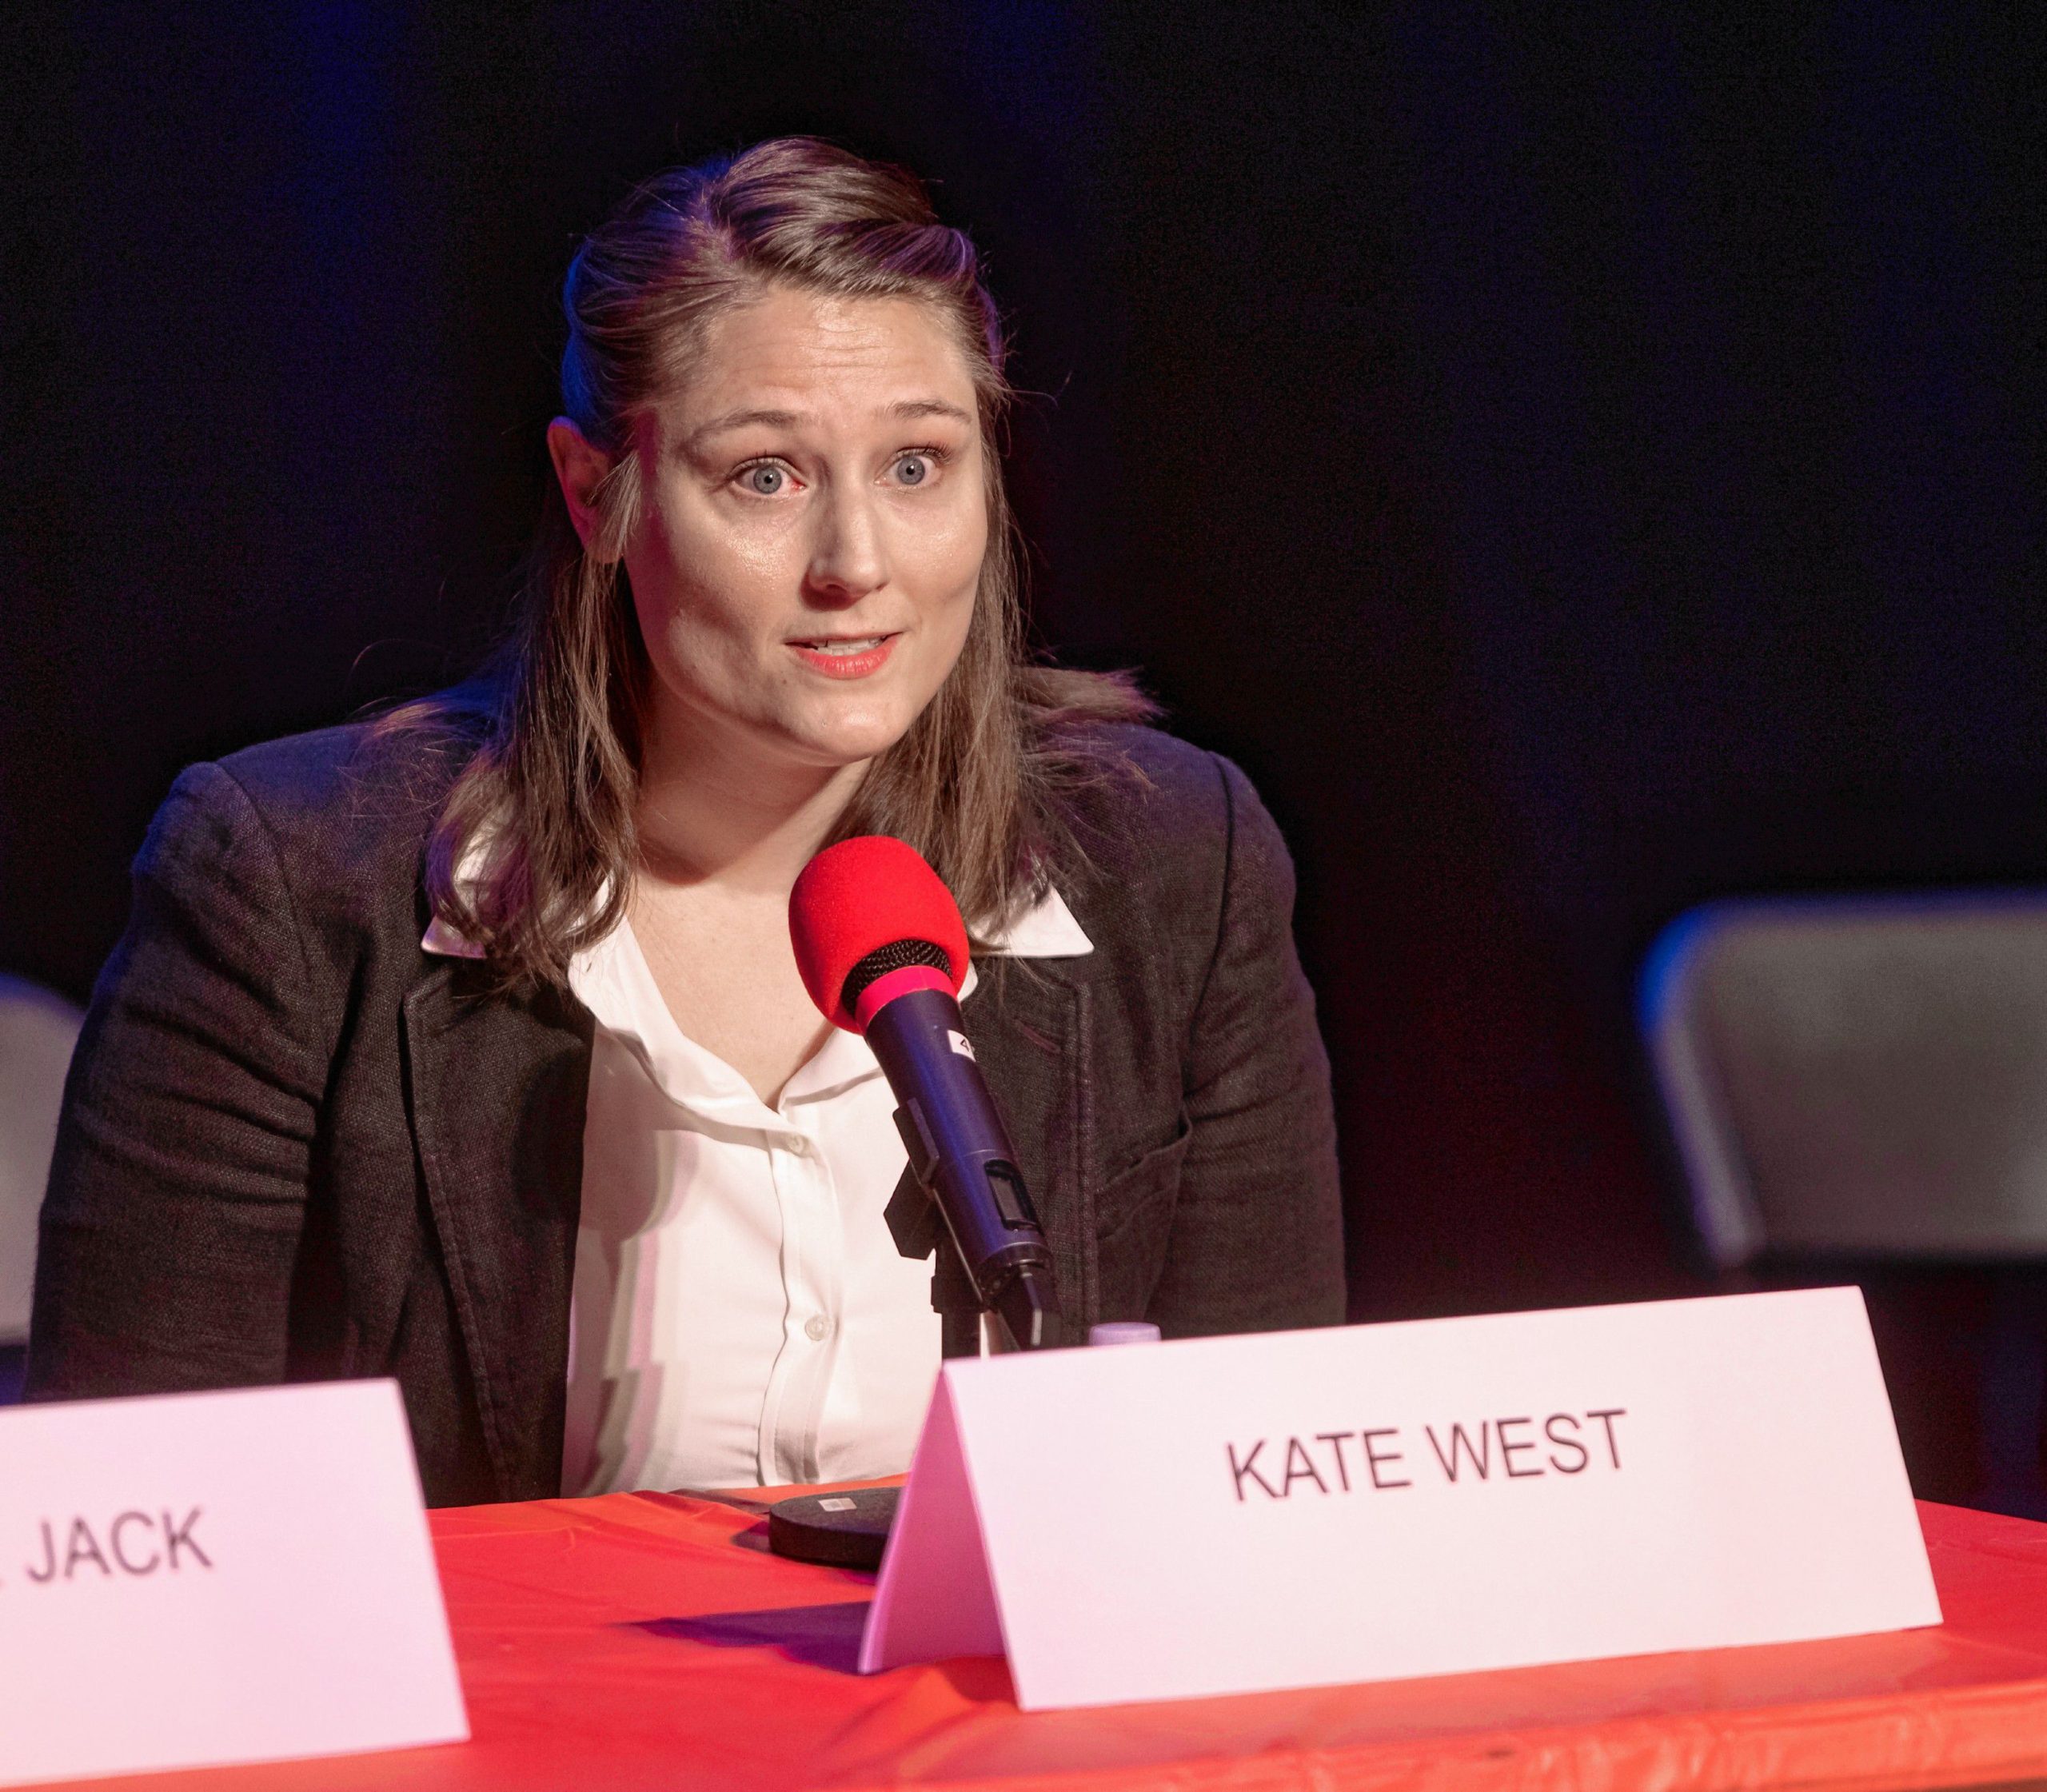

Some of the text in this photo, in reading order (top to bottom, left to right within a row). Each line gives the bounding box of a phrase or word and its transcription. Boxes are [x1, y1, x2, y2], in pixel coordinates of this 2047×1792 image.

[1226, 1407, 1626, 1502] KATE WEST
[26, 1507, 213, 1583] JACK
